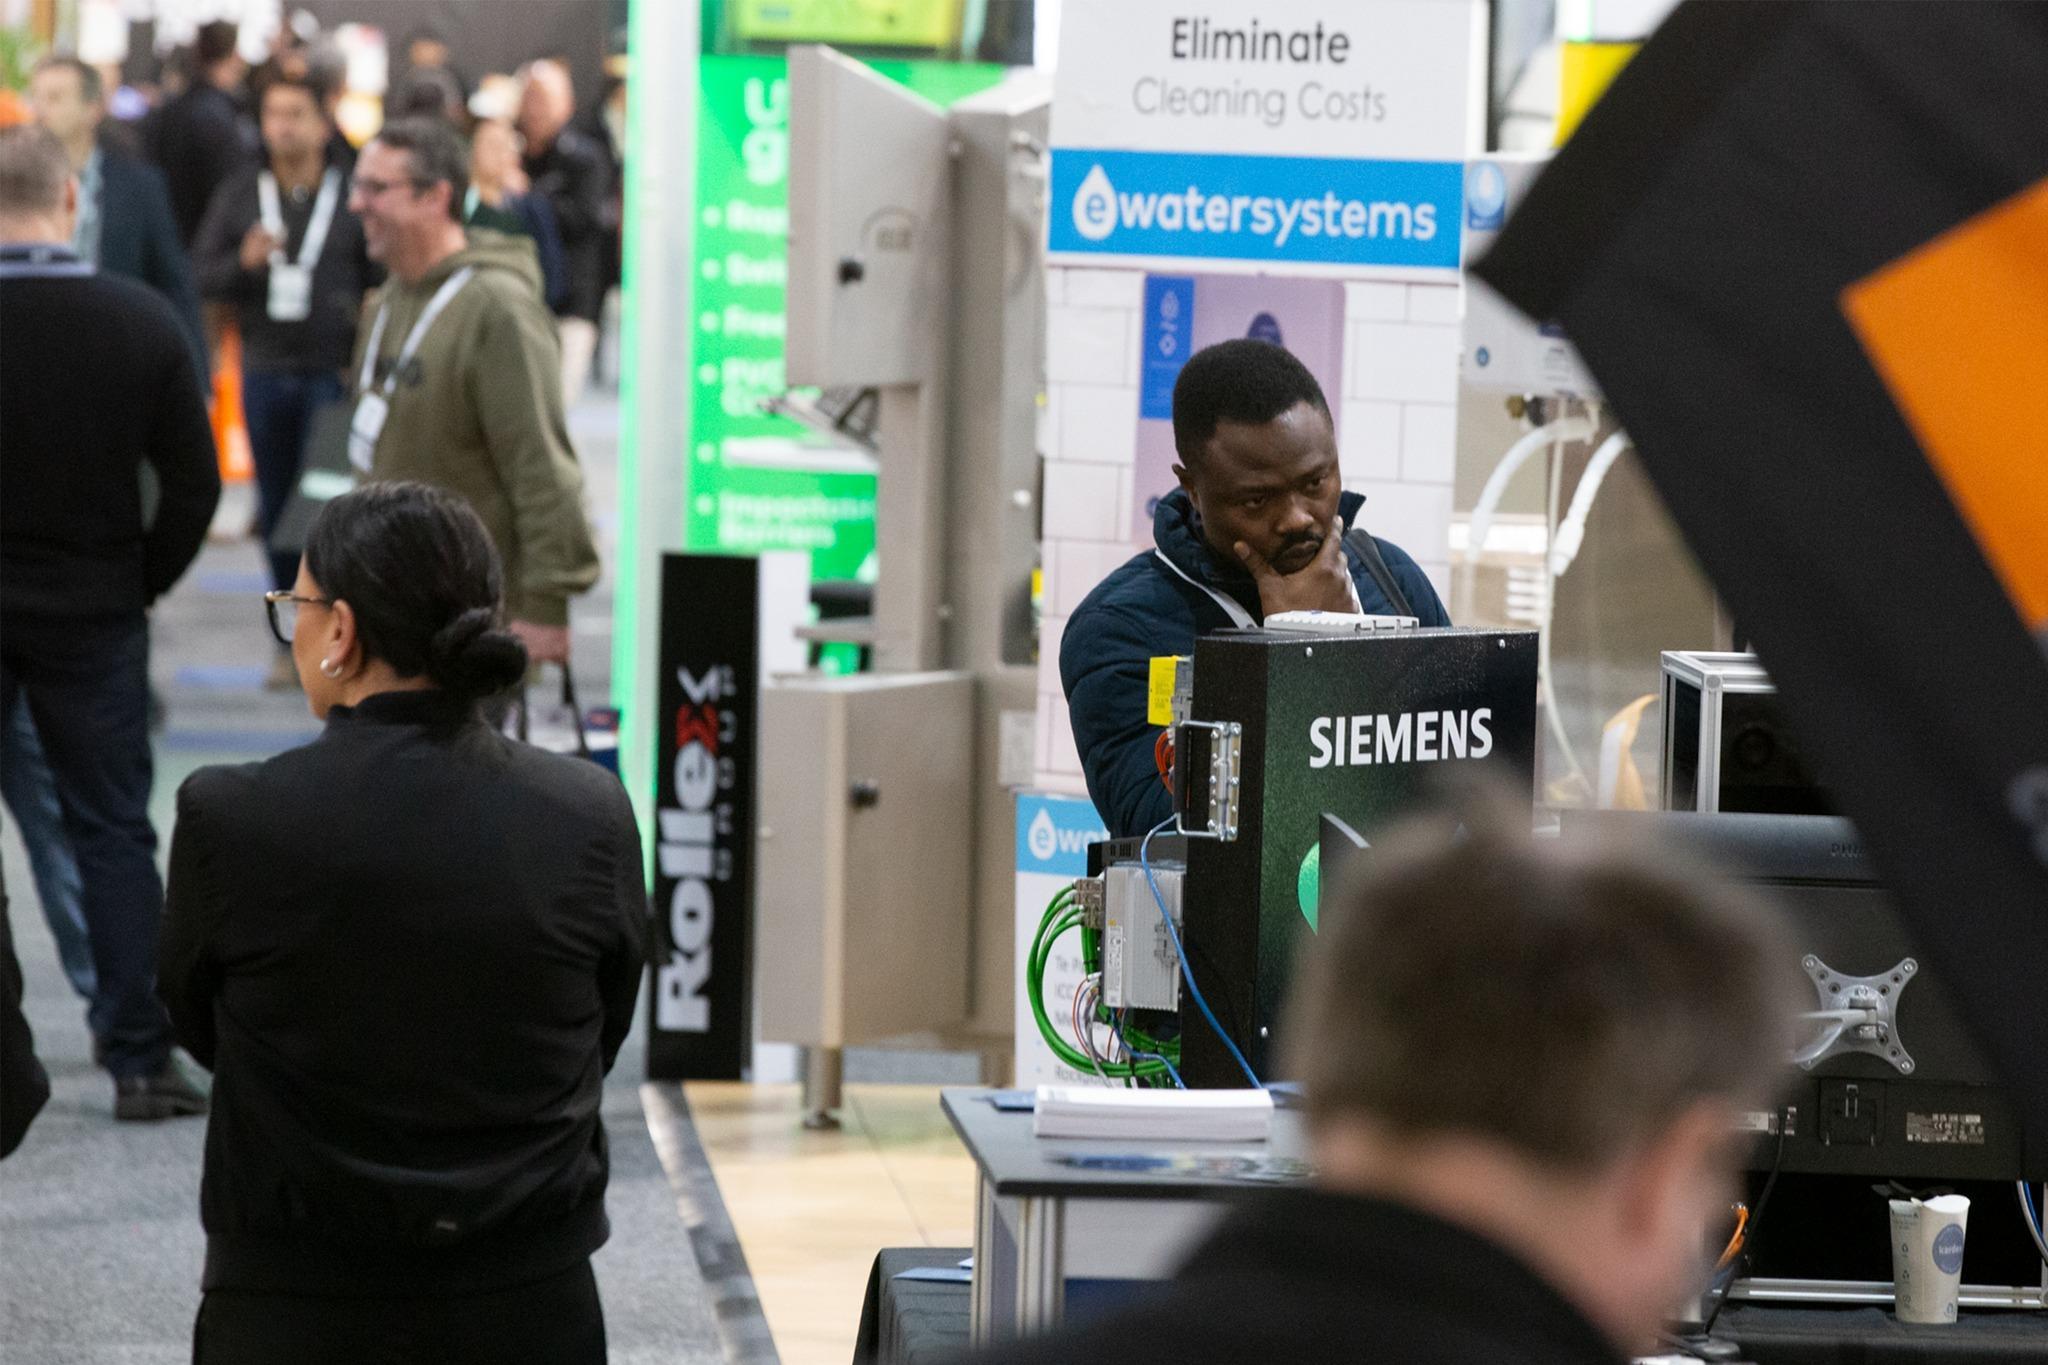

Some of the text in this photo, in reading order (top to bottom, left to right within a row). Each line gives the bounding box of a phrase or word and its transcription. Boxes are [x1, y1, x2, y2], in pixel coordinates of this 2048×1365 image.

[1172, 18, 1351, 64] Eliminate
[1132, 76, 1386, 127] Cleaning Costs
[1078, 178, 1438, 247] ewatersystems
[1310, 708, 1493, 768] SIEMENS
